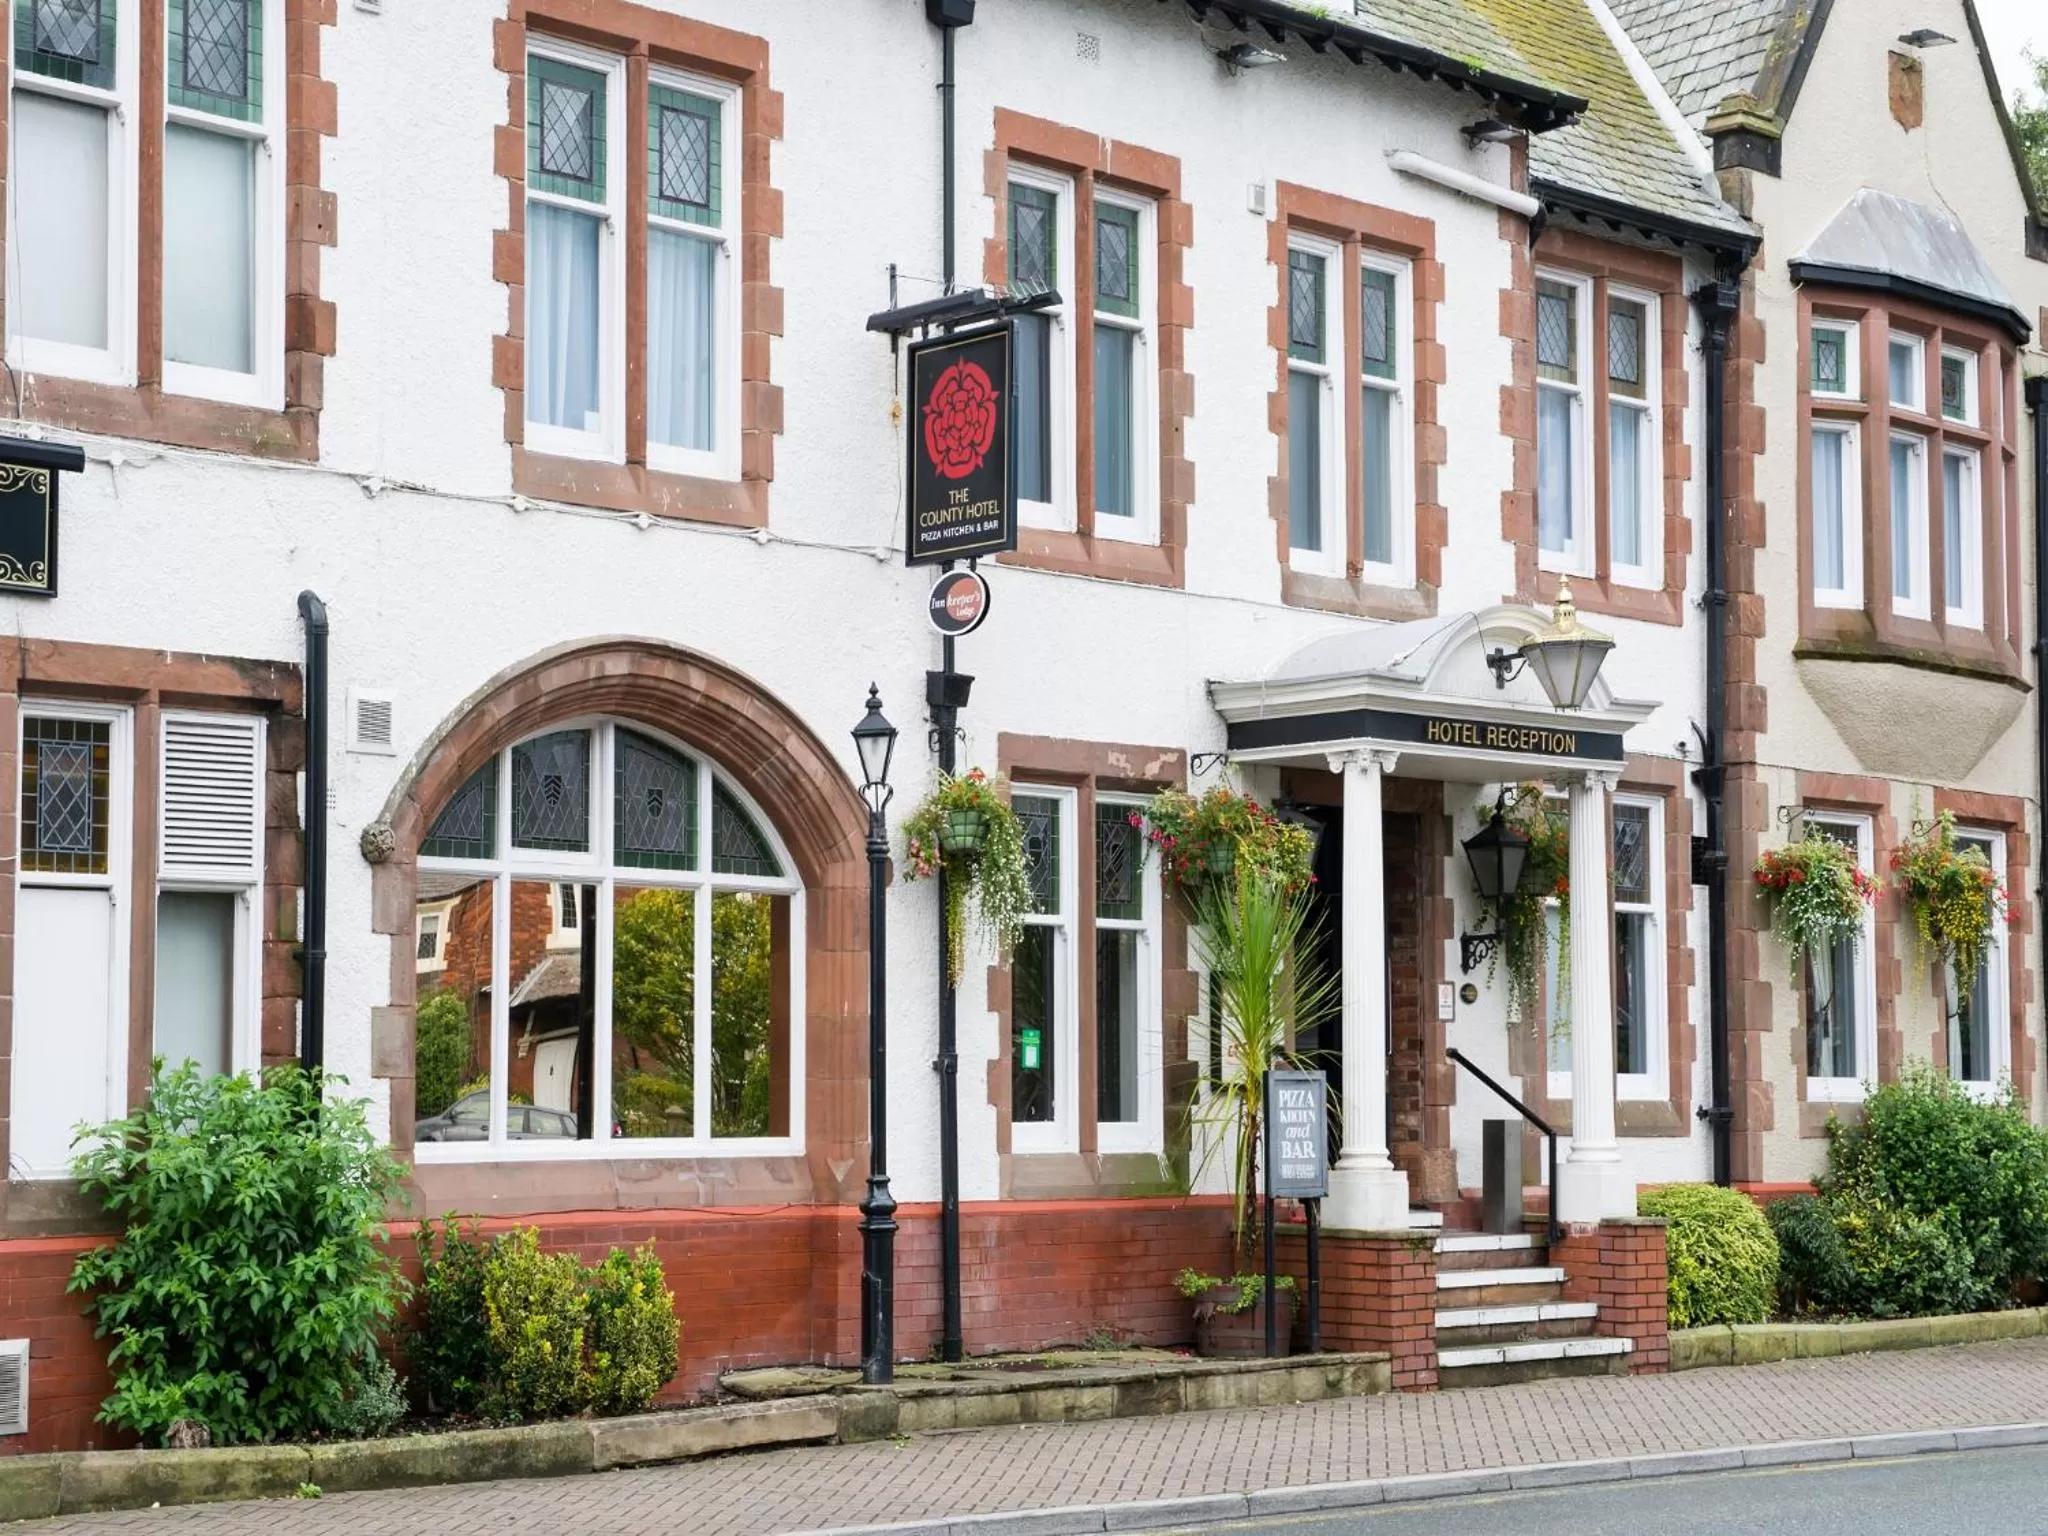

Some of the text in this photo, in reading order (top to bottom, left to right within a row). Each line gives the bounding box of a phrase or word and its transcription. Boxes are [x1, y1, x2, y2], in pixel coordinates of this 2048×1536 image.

[949, 487, 969, 505] THE
[919, 500, 1000, 527] COUNTY HOTEL
[920, 520, 999, 542] PIZZA KITCHEN & BAR
[1428, 720, 1576, 754] HOTEL RECEPTION
[1279, 1090, 1315, 1108] PIZZA
[1285, 1124, 1311, 1139] and
[1281, 1141, 1316, 1159] BAR
